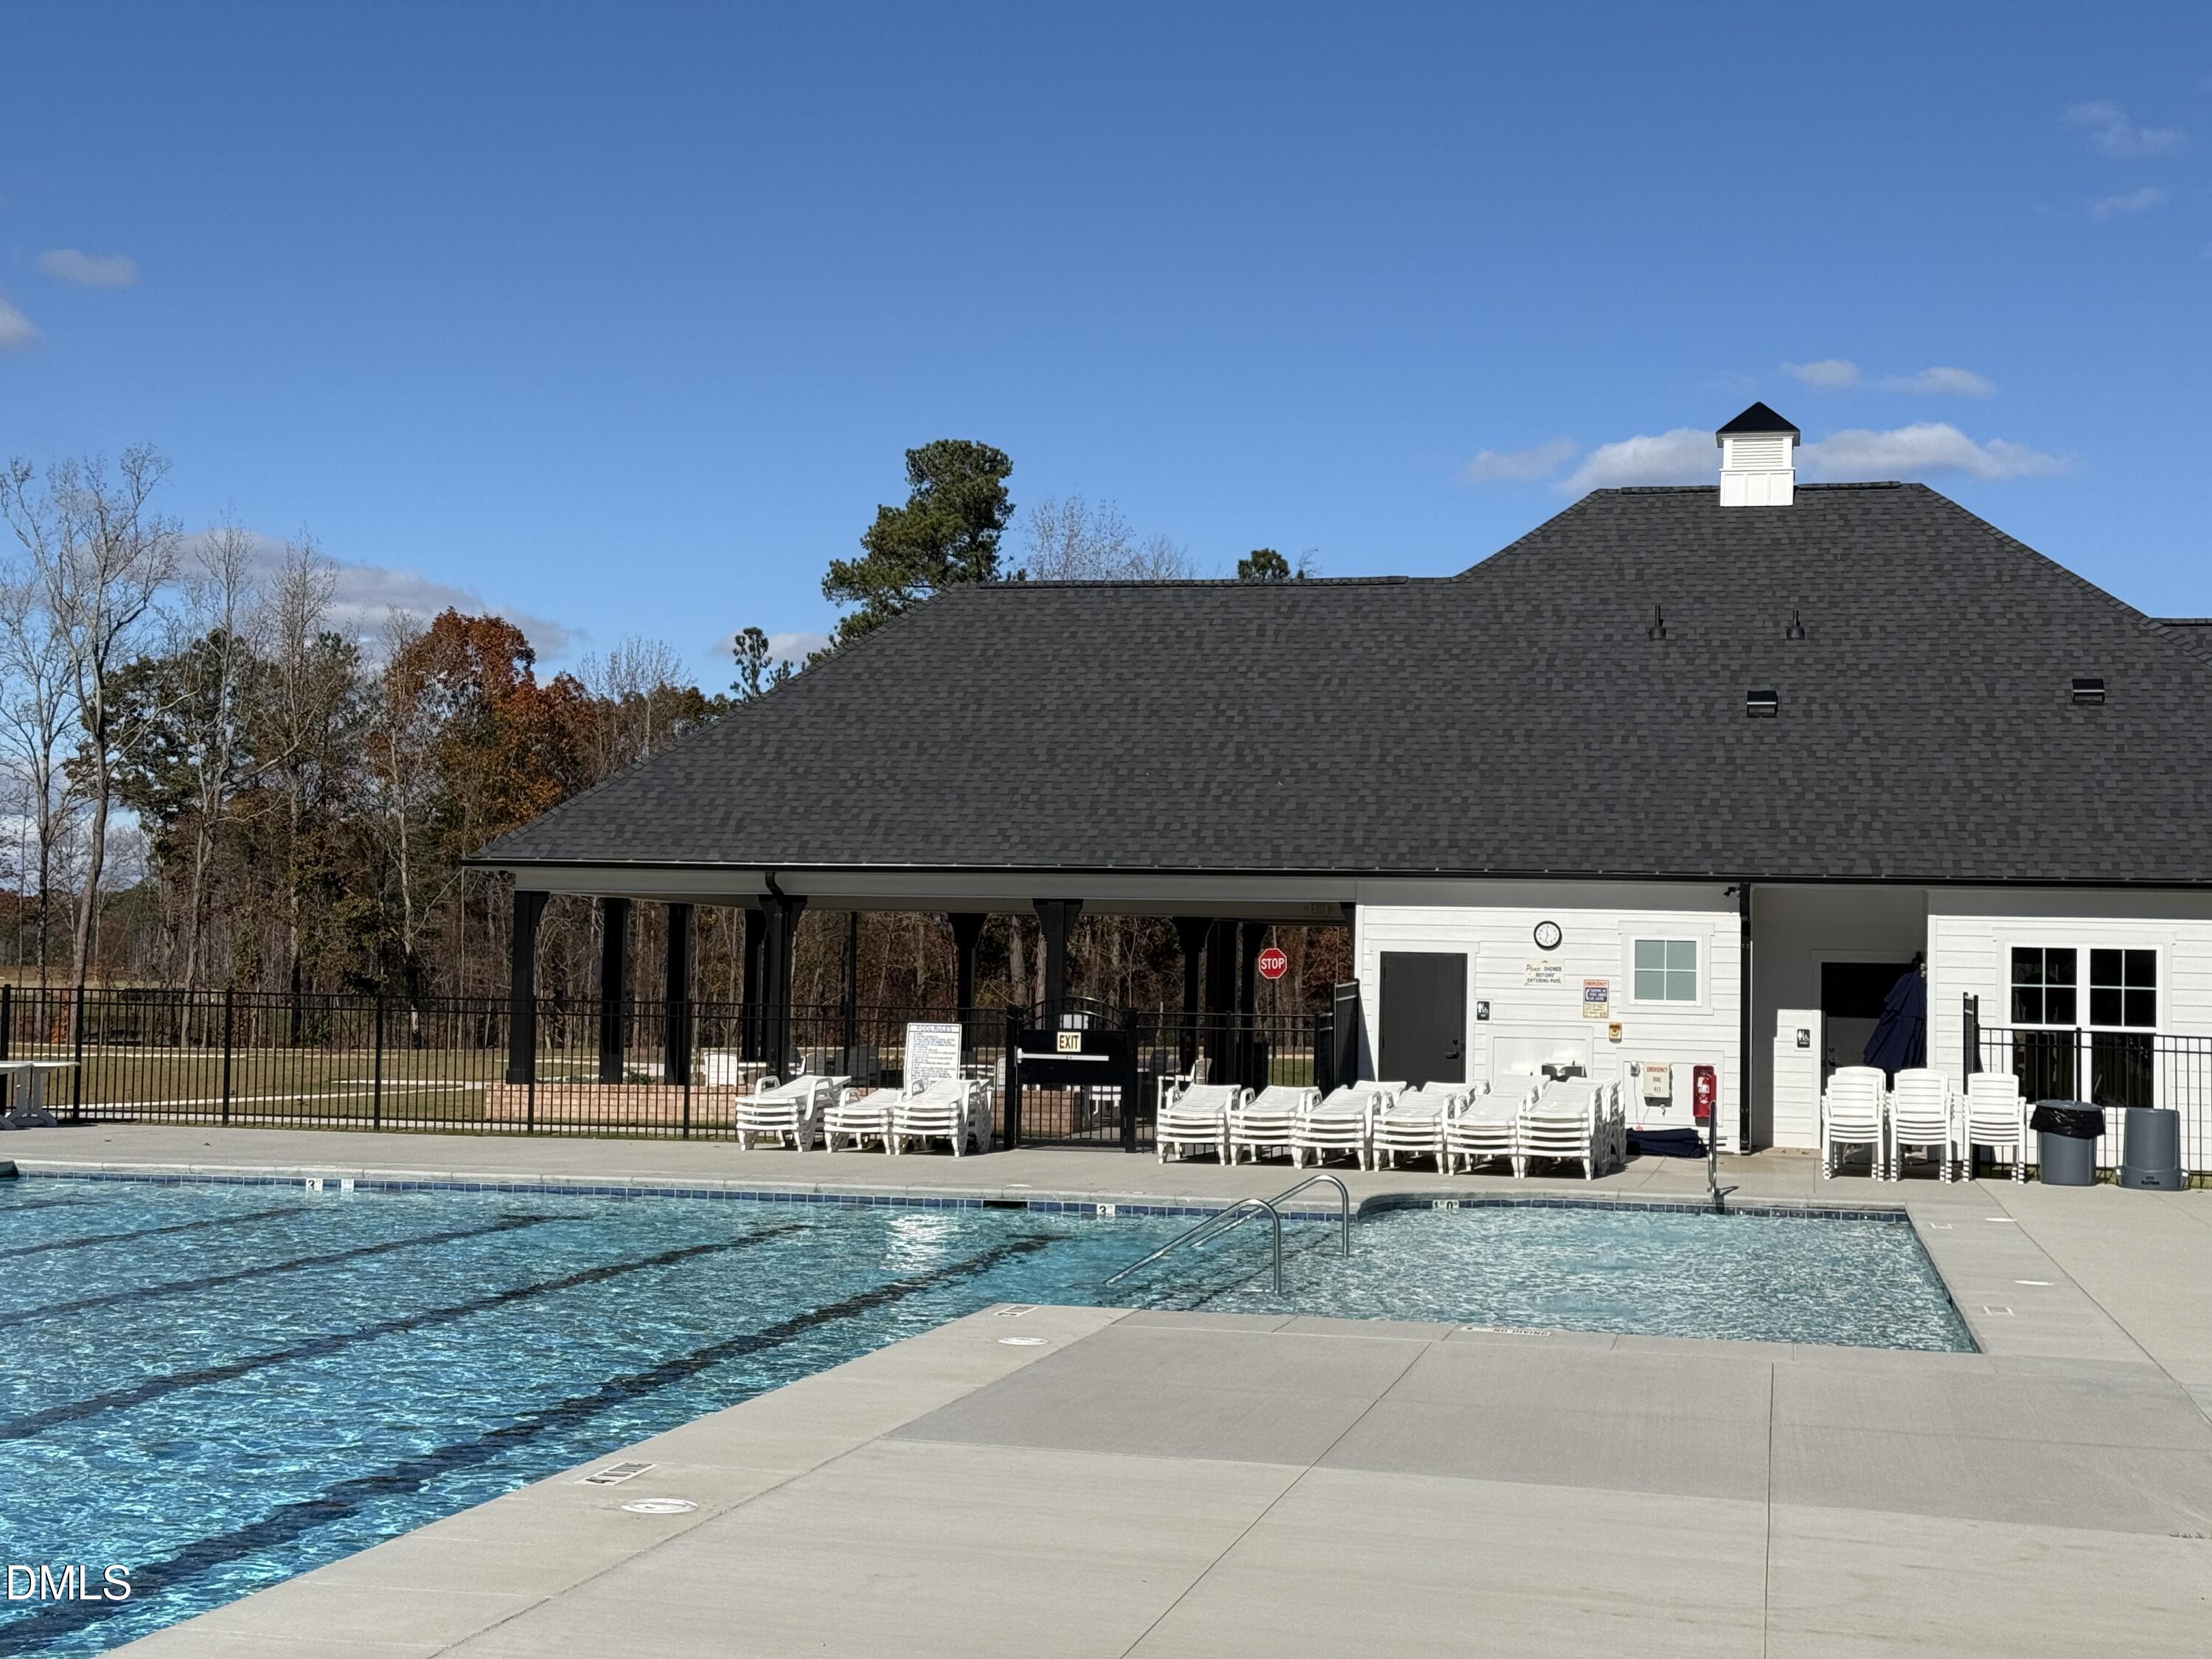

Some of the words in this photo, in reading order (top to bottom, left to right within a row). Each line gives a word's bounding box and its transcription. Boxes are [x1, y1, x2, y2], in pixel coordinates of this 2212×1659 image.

[1261, 958, 1284, 970] STOP
[1060, 1034, 1079, 1050] EXIT
[1099, 1206, 1107, 1216] 3
